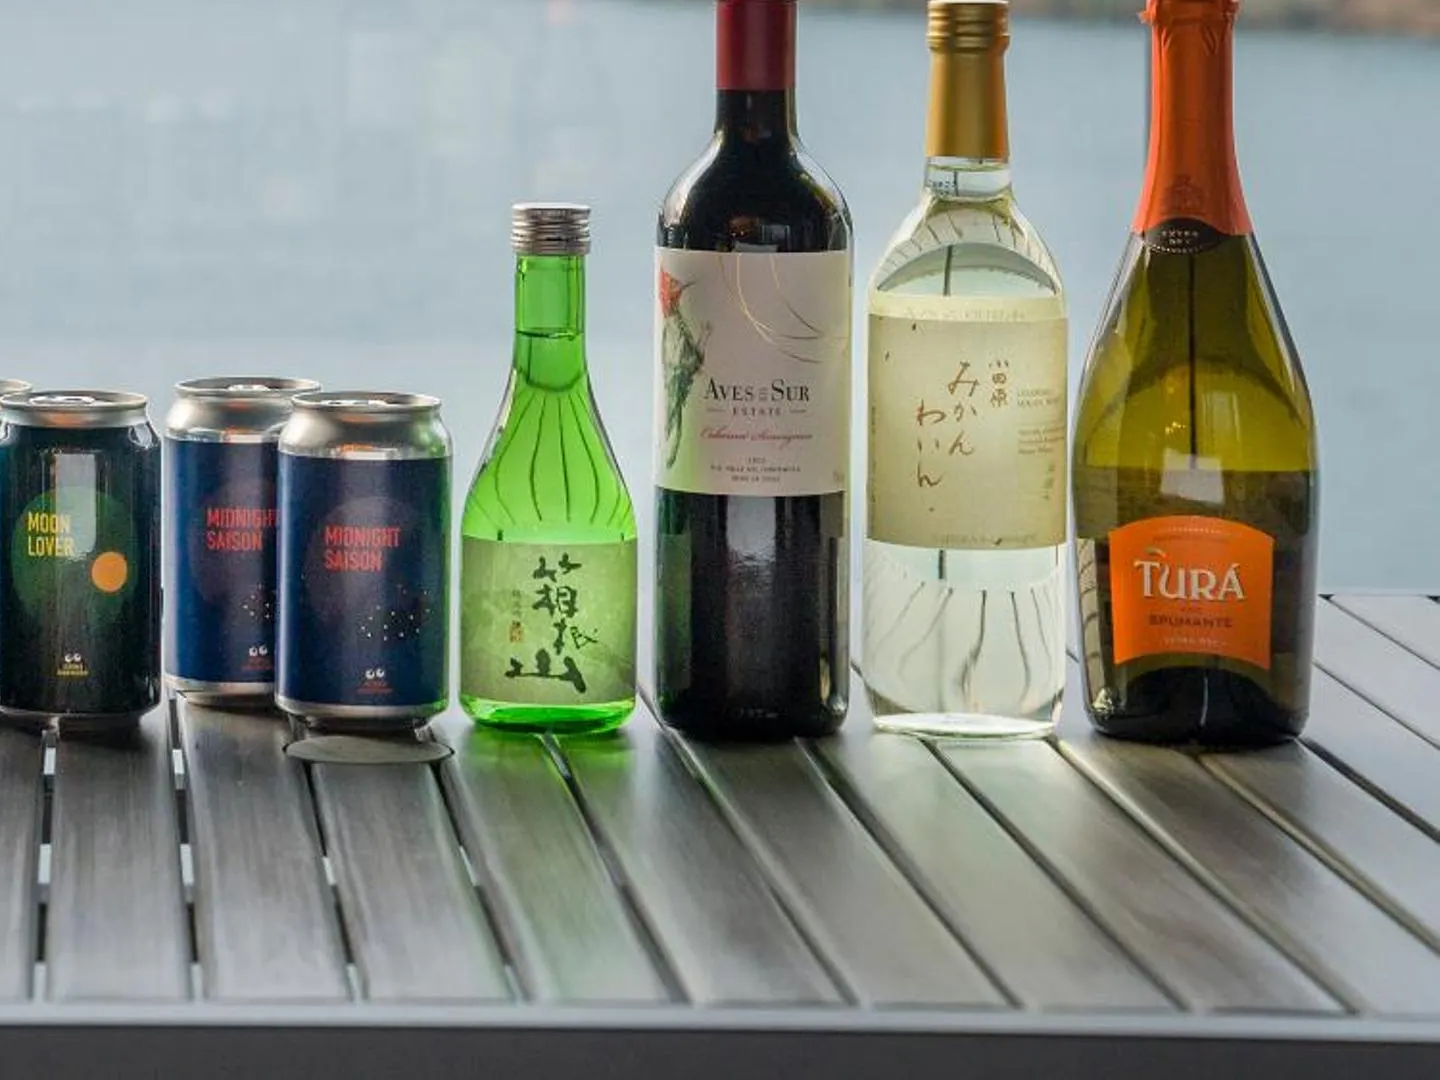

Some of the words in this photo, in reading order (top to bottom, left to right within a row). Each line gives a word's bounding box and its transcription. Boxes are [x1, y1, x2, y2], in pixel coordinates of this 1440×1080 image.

[703, 377, 754, 401] AVES
[771, 378, 810, 402] SUR
[947, 360, 981, 457] みかん
[916, 398, 948, 488] わいん
[27, 511, 71, 534] MOON
[28, 535, 75, 558] LOVER
[206, 530, 263, 552] SAISON
[325, 525, 402, 549] MIDNIGHT
[324, 550, 383, 572] SAISON
[504, 552, 599, 694] 箱根山
